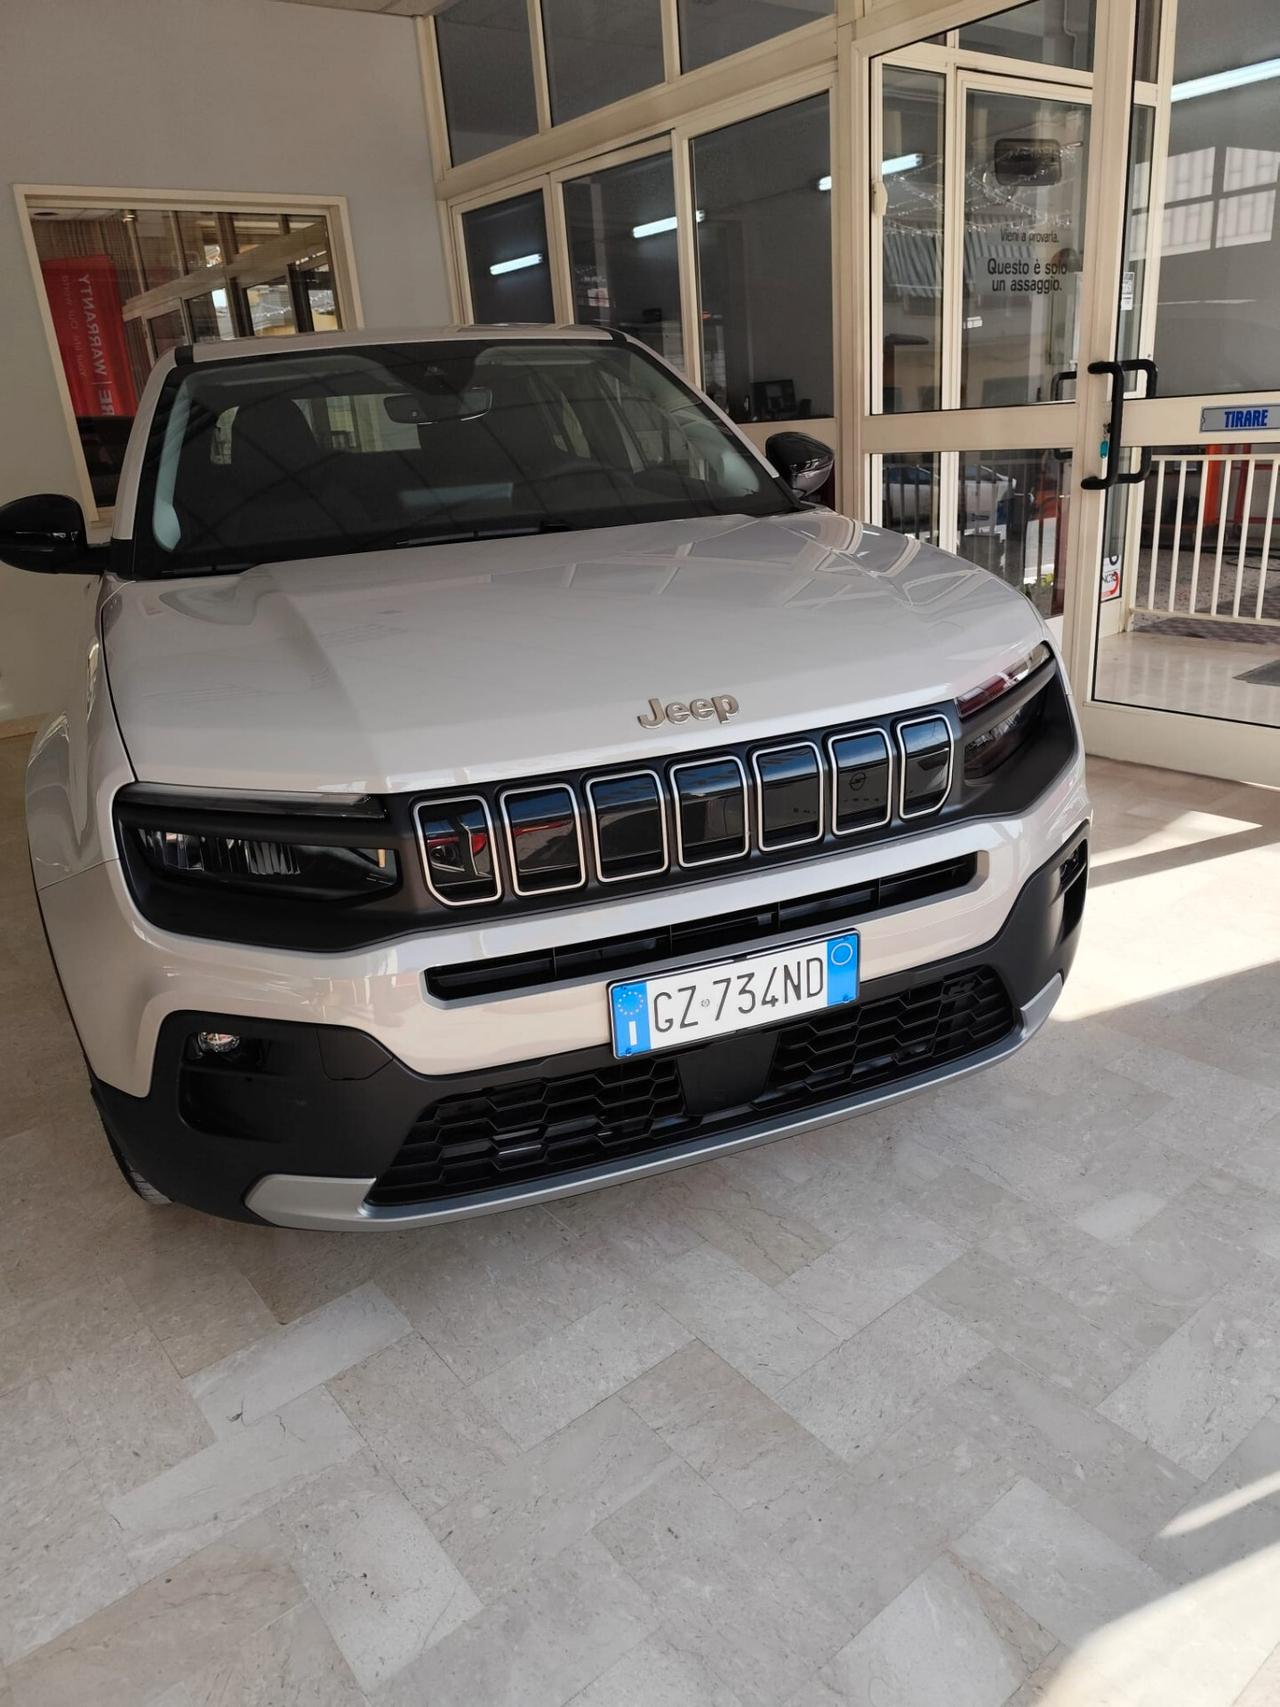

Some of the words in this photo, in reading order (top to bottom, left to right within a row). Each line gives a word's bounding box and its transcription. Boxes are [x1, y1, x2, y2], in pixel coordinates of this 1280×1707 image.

[987, 258, 1030, 275] Questo
[1034, 259, 1041, 275] è
[1045, 259, 1068, 275] solo
[992, 280, 1006, 292] un
[1010, 276, 1062, 294] assaggio.
[1224, 409, 1269, 428] TIRARE
[637, 694, 739, 729] Jeep
